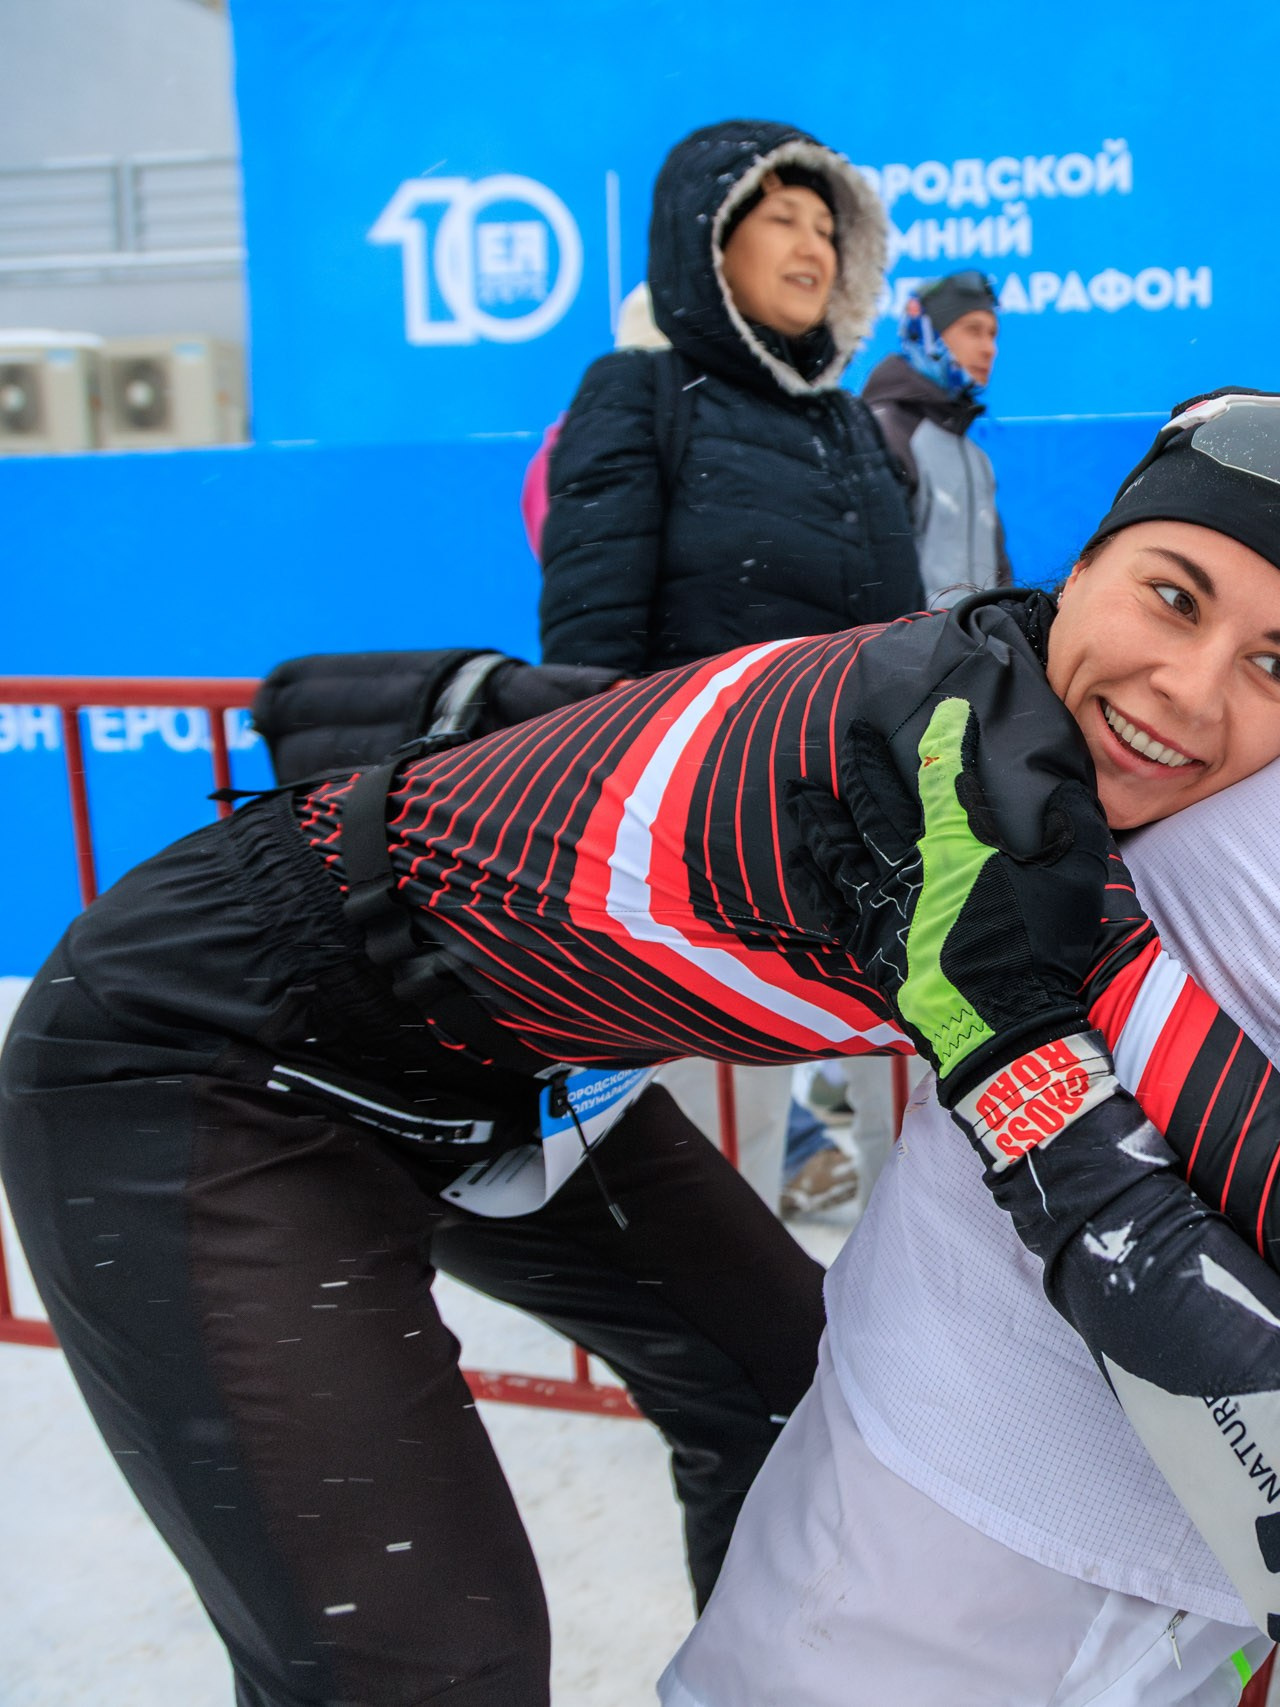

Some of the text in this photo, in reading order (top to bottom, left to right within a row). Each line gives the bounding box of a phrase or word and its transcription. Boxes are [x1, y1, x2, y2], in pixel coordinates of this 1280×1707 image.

[854, 137, 1133, 209] РОДСКОЙ
[887, 200, 1032, 260] МНИЙ
[567, 1069, 633, 1103] ОРОДСКОЙ
[975, 1038, 1082, 1132] ROAD
[995, 1067, 1090, 1165] CROSS
